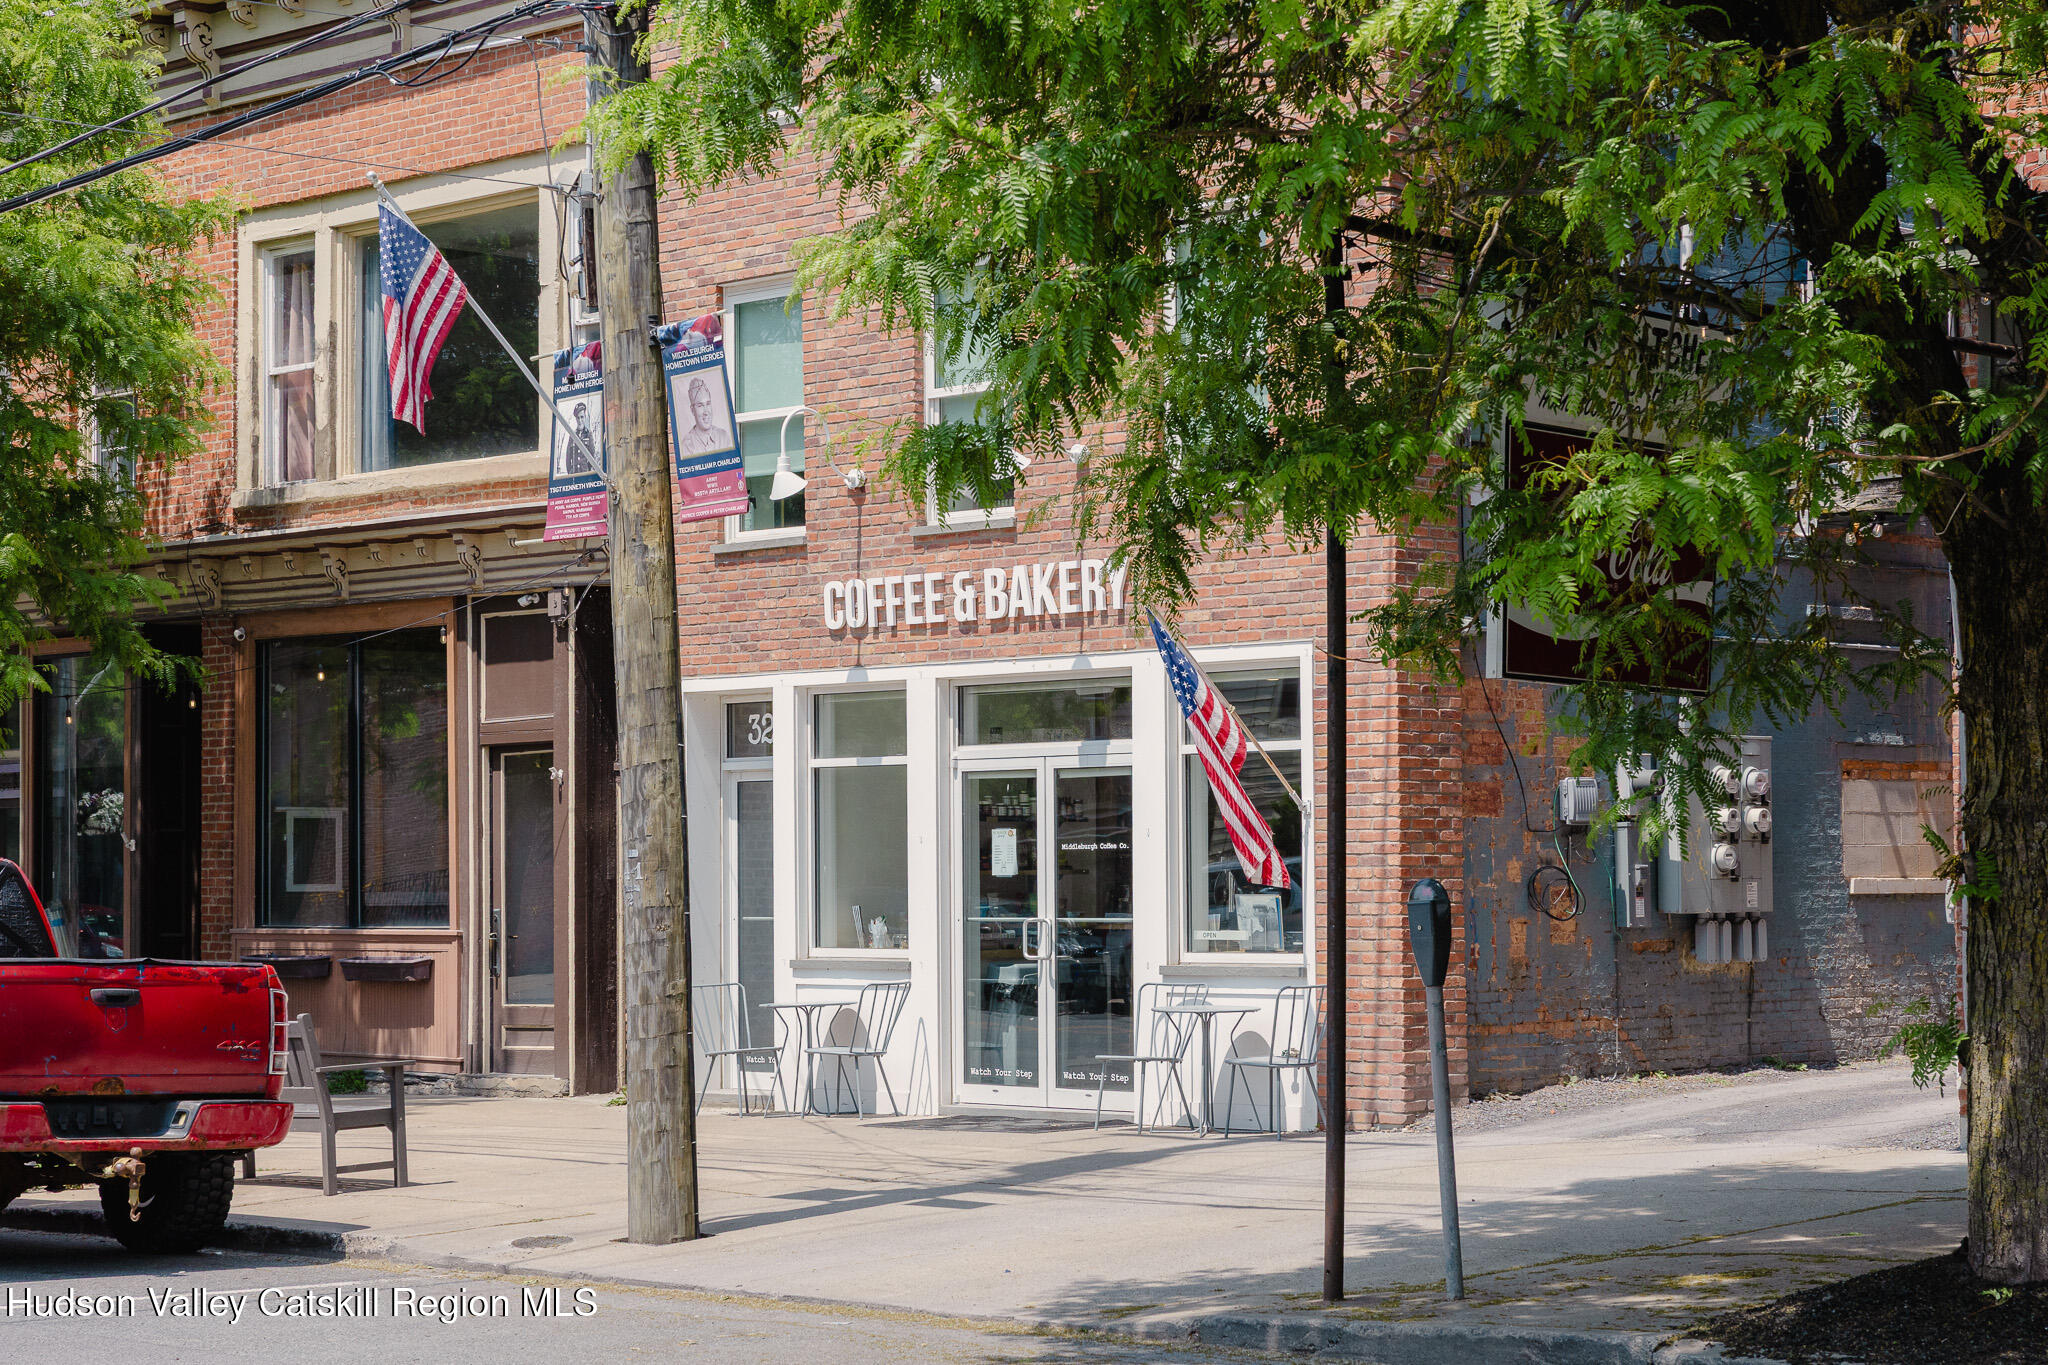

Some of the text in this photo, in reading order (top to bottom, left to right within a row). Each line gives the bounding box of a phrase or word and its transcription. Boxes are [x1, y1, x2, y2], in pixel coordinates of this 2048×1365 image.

[671, 344, 714, 360] MIDDLEBURGH
[665, 351, 724, 371] HOMETOWN HEROES
[562, 370, 598, 384] MLEBURGH
[554, 381, 585, 394] HOMETOWN
[694, 462, 712, 471] WILLIAM
[717, 457, 740, 467] CHARLAND
[562, 483, 585, 492] KENNETH
[823, 556, 1129, 630] COFFEE & BAKERY
[1061, 843, 1098, 851] Middleburgh
[745, 1055, 766, 1064] Watch
[970, 1067, 1033, 1080] Watch Your Step
[1063, 1071, 1086, 1080] Watch
[1110, 1073, 1129, 1084] Step
